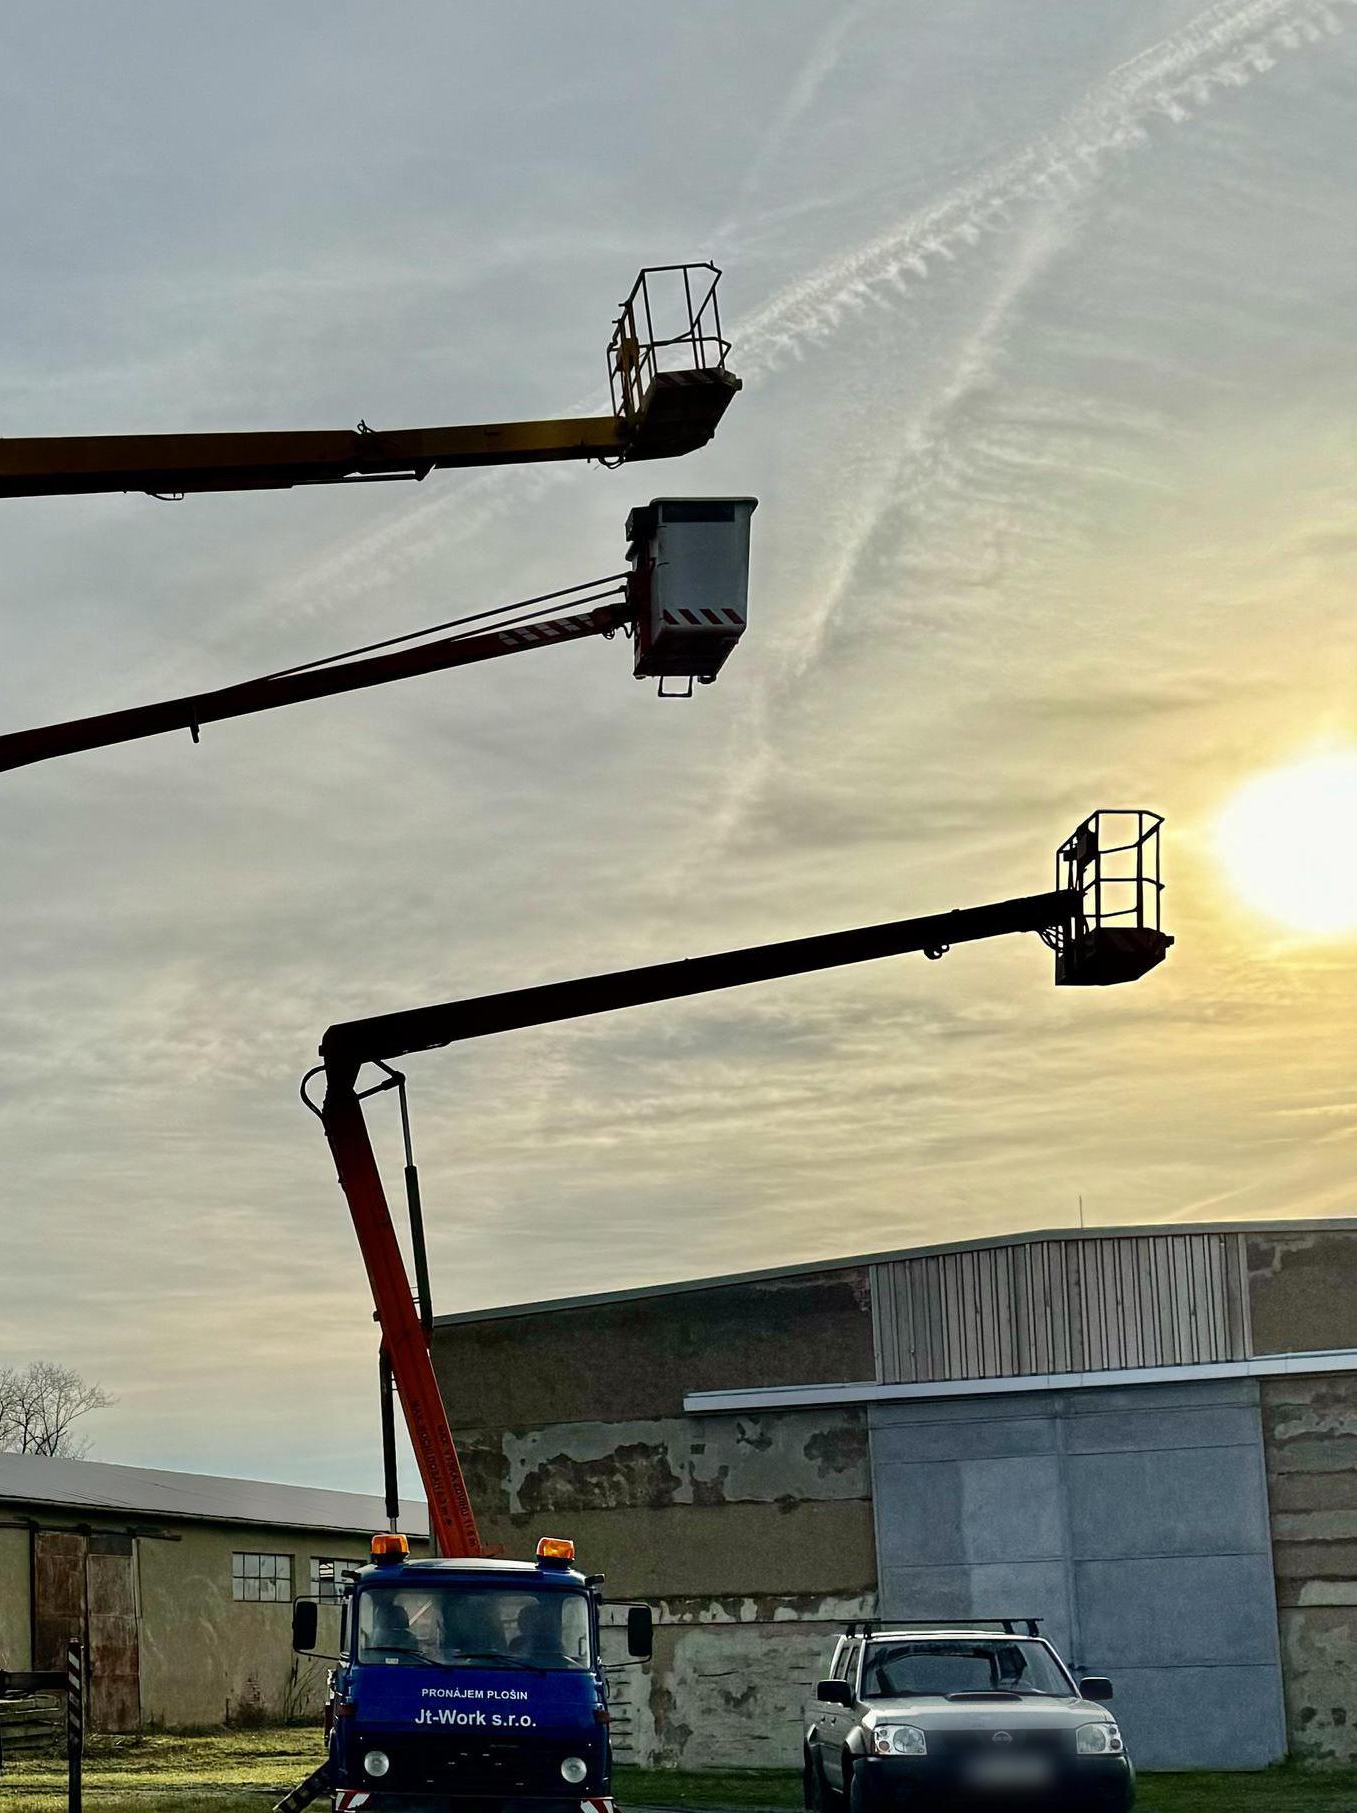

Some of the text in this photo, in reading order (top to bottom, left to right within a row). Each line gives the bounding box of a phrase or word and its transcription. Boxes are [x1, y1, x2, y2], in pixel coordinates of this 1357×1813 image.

[421, 1687, 528, 1700] PRONÁJEM PLOŠIN
[414, 1708, 537, 1727] Jt-Work s.r.o.
